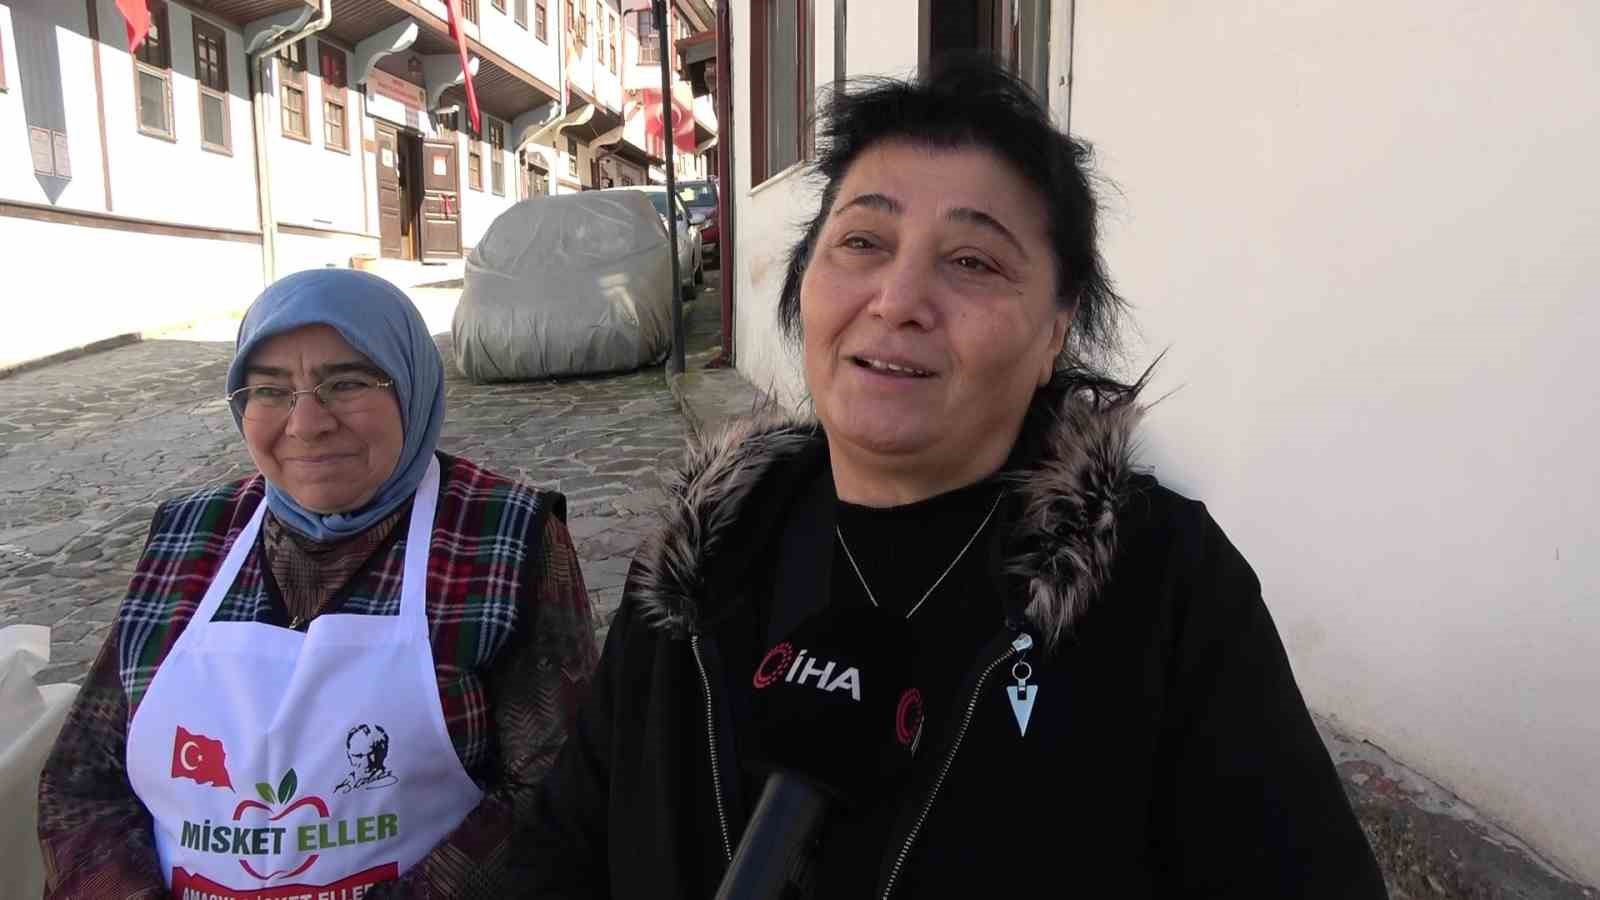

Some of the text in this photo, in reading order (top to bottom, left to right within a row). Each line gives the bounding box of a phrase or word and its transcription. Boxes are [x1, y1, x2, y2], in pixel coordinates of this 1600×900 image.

[785, 649, 861, 701] İHA
[180, 813, 399, 855] MİSKET ELLER
